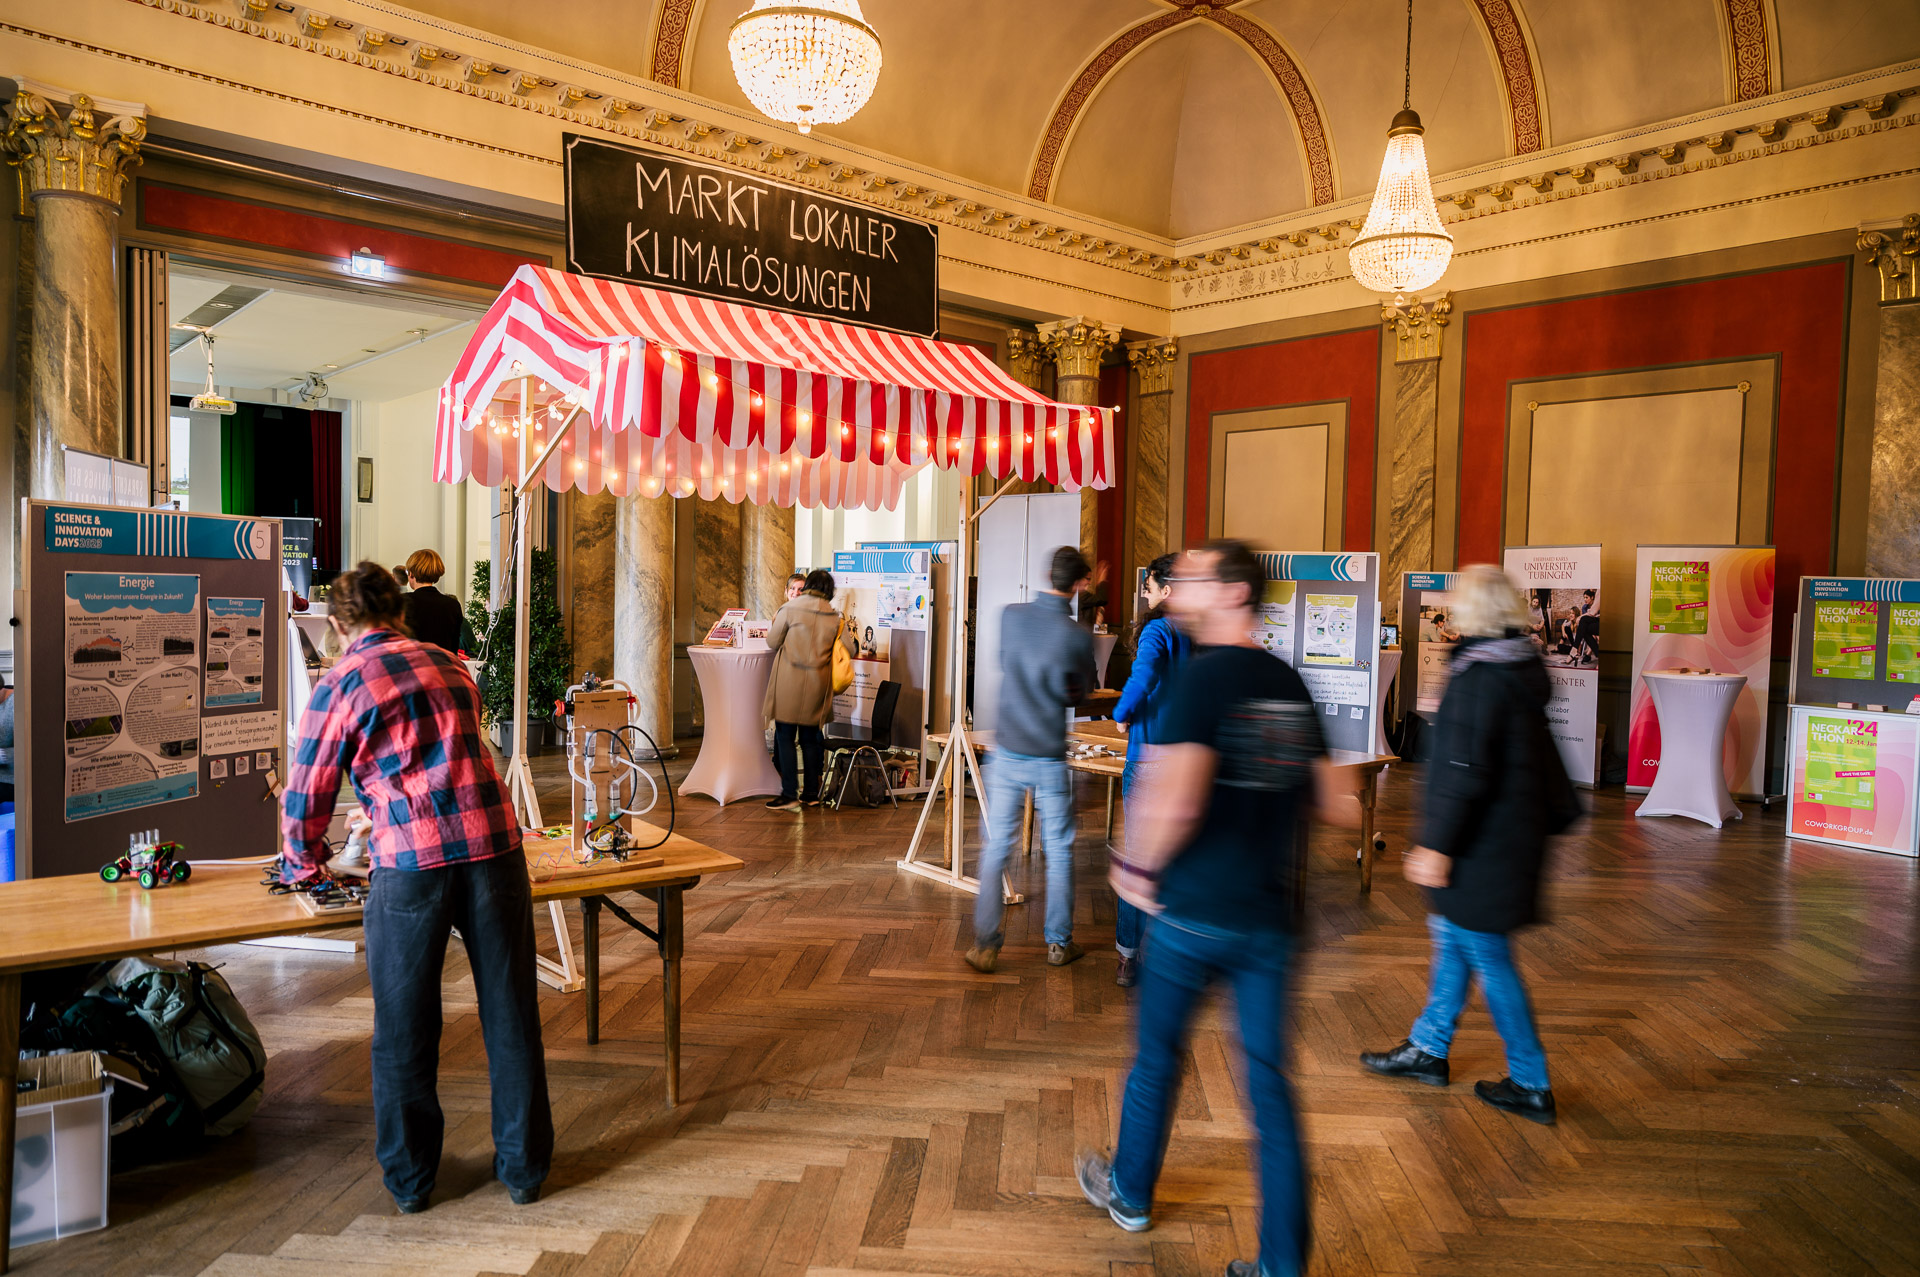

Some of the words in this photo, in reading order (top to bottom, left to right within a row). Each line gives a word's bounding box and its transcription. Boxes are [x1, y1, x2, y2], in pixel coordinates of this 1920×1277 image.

[636, 161, 769, 231] MARKT
[789, 199, 899, 263] LOKALER
[626, 221, 871, 312] KLIMALÖSUNGEN
[54, 512, 92, 525] SCIENCE
[94, 516, 101, 525] &
[55, 525, 112, 538] INNOVATION
[255, 530, 265, 549] 5
[1350, 561, 1359, 574] 5
[119, 576, 155, 591] Energie
[1818, 615, 1849, 623] THON
[1550, 675, 1586, 687] CENTER
[1812, 732, 1845, 743] THON
[1804, 820, 1874, 836] COWORKGROUP.de
